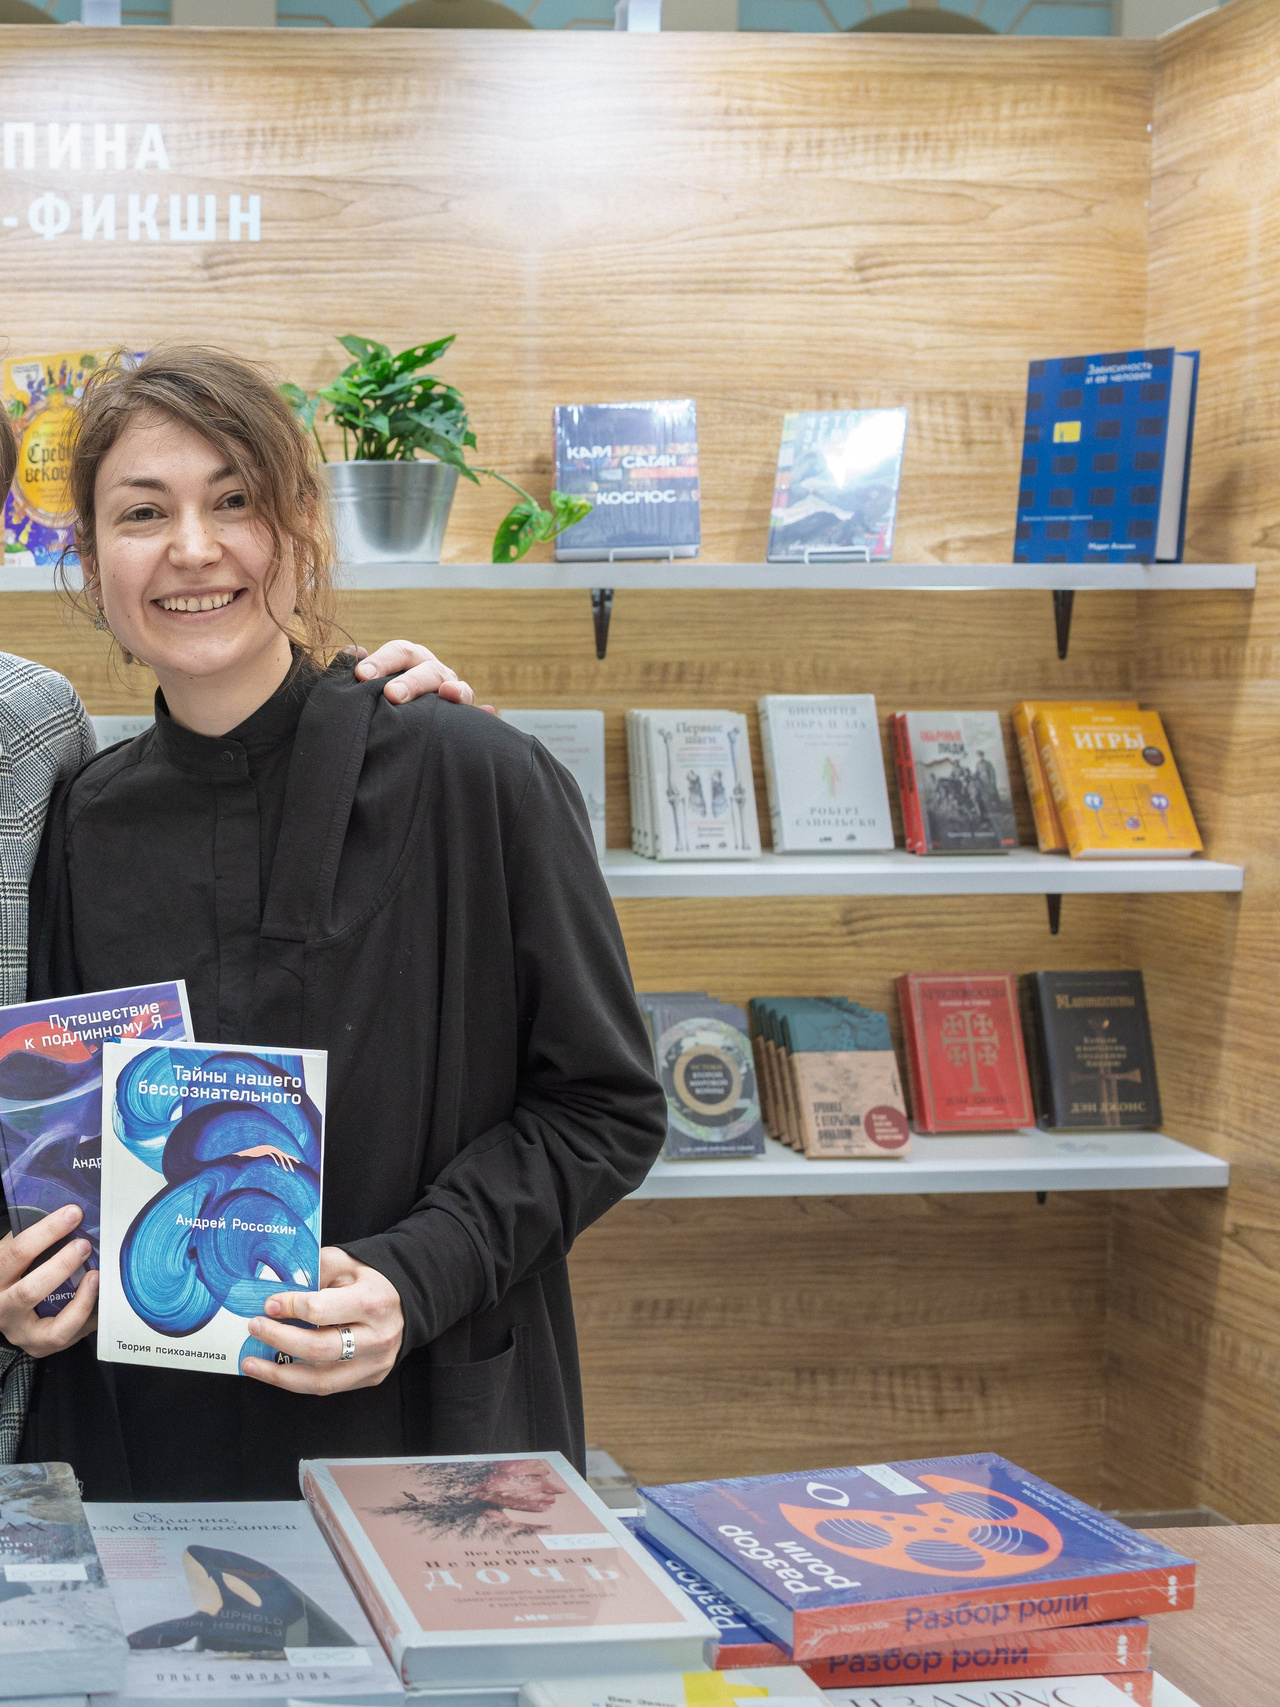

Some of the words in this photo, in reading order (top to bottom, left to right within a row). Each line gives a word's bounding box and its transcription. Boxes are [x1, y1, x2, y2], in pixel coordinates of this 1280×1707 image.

[1087, 361, 1153, 375] Зависимость
[566, 445, 612, 460] КАРЛ
[621, 454, 677, 469] САГАН
[596, 488, 677, 505] КОСМОС
[1073, 732, 1146, 750] ИГРЫ
[49, 1002, 160, 1030] Путешествие
[24, 1038, 36, 1050] к
[41, 1020, 143, 1048] подлинному
[151, 1014, 164, 1031] Я
[173, 1064, 227, 1084] Тайны
[235, 1073, 302, 1089] нашего
[138, 1080, 302, 1105] бессознательного
[1070, 1102, 1097, 1114] ДЭН
[1099, 1101, 1147, 1113] ДЖОНС
[175, 1213, 226, 1231] Андрей
[232, 1218, 297, 1236] Россохин
[116, 1340, 151, 1354] Теория
[155, 1345, 227, 1361] психоанализа
[133, 1511, 237, 1525] Облачно,
[199, 1523, 301, 1532] косатки
[424, 1556, 594, 1568] Нелюбимая
[495, 1549, 540, 1557] Стрип
[718, 1524, 821, 1594] Разбор
[774, 1540, 861, 1589] роли
[422, 1565, 620, 1592] ДОЧЬ
[904, 1600, 1010, 1632] Разбор
[1018, 1592, 1090, 1621] роли
[828, 1646, 943, 1675] Разбор
[952, 1645, 1029, 1673] роли
[156, 1672, 215, 1682] ОЛЬГА
[230, 1671, 331, 1682] ФИЛАТОВА
